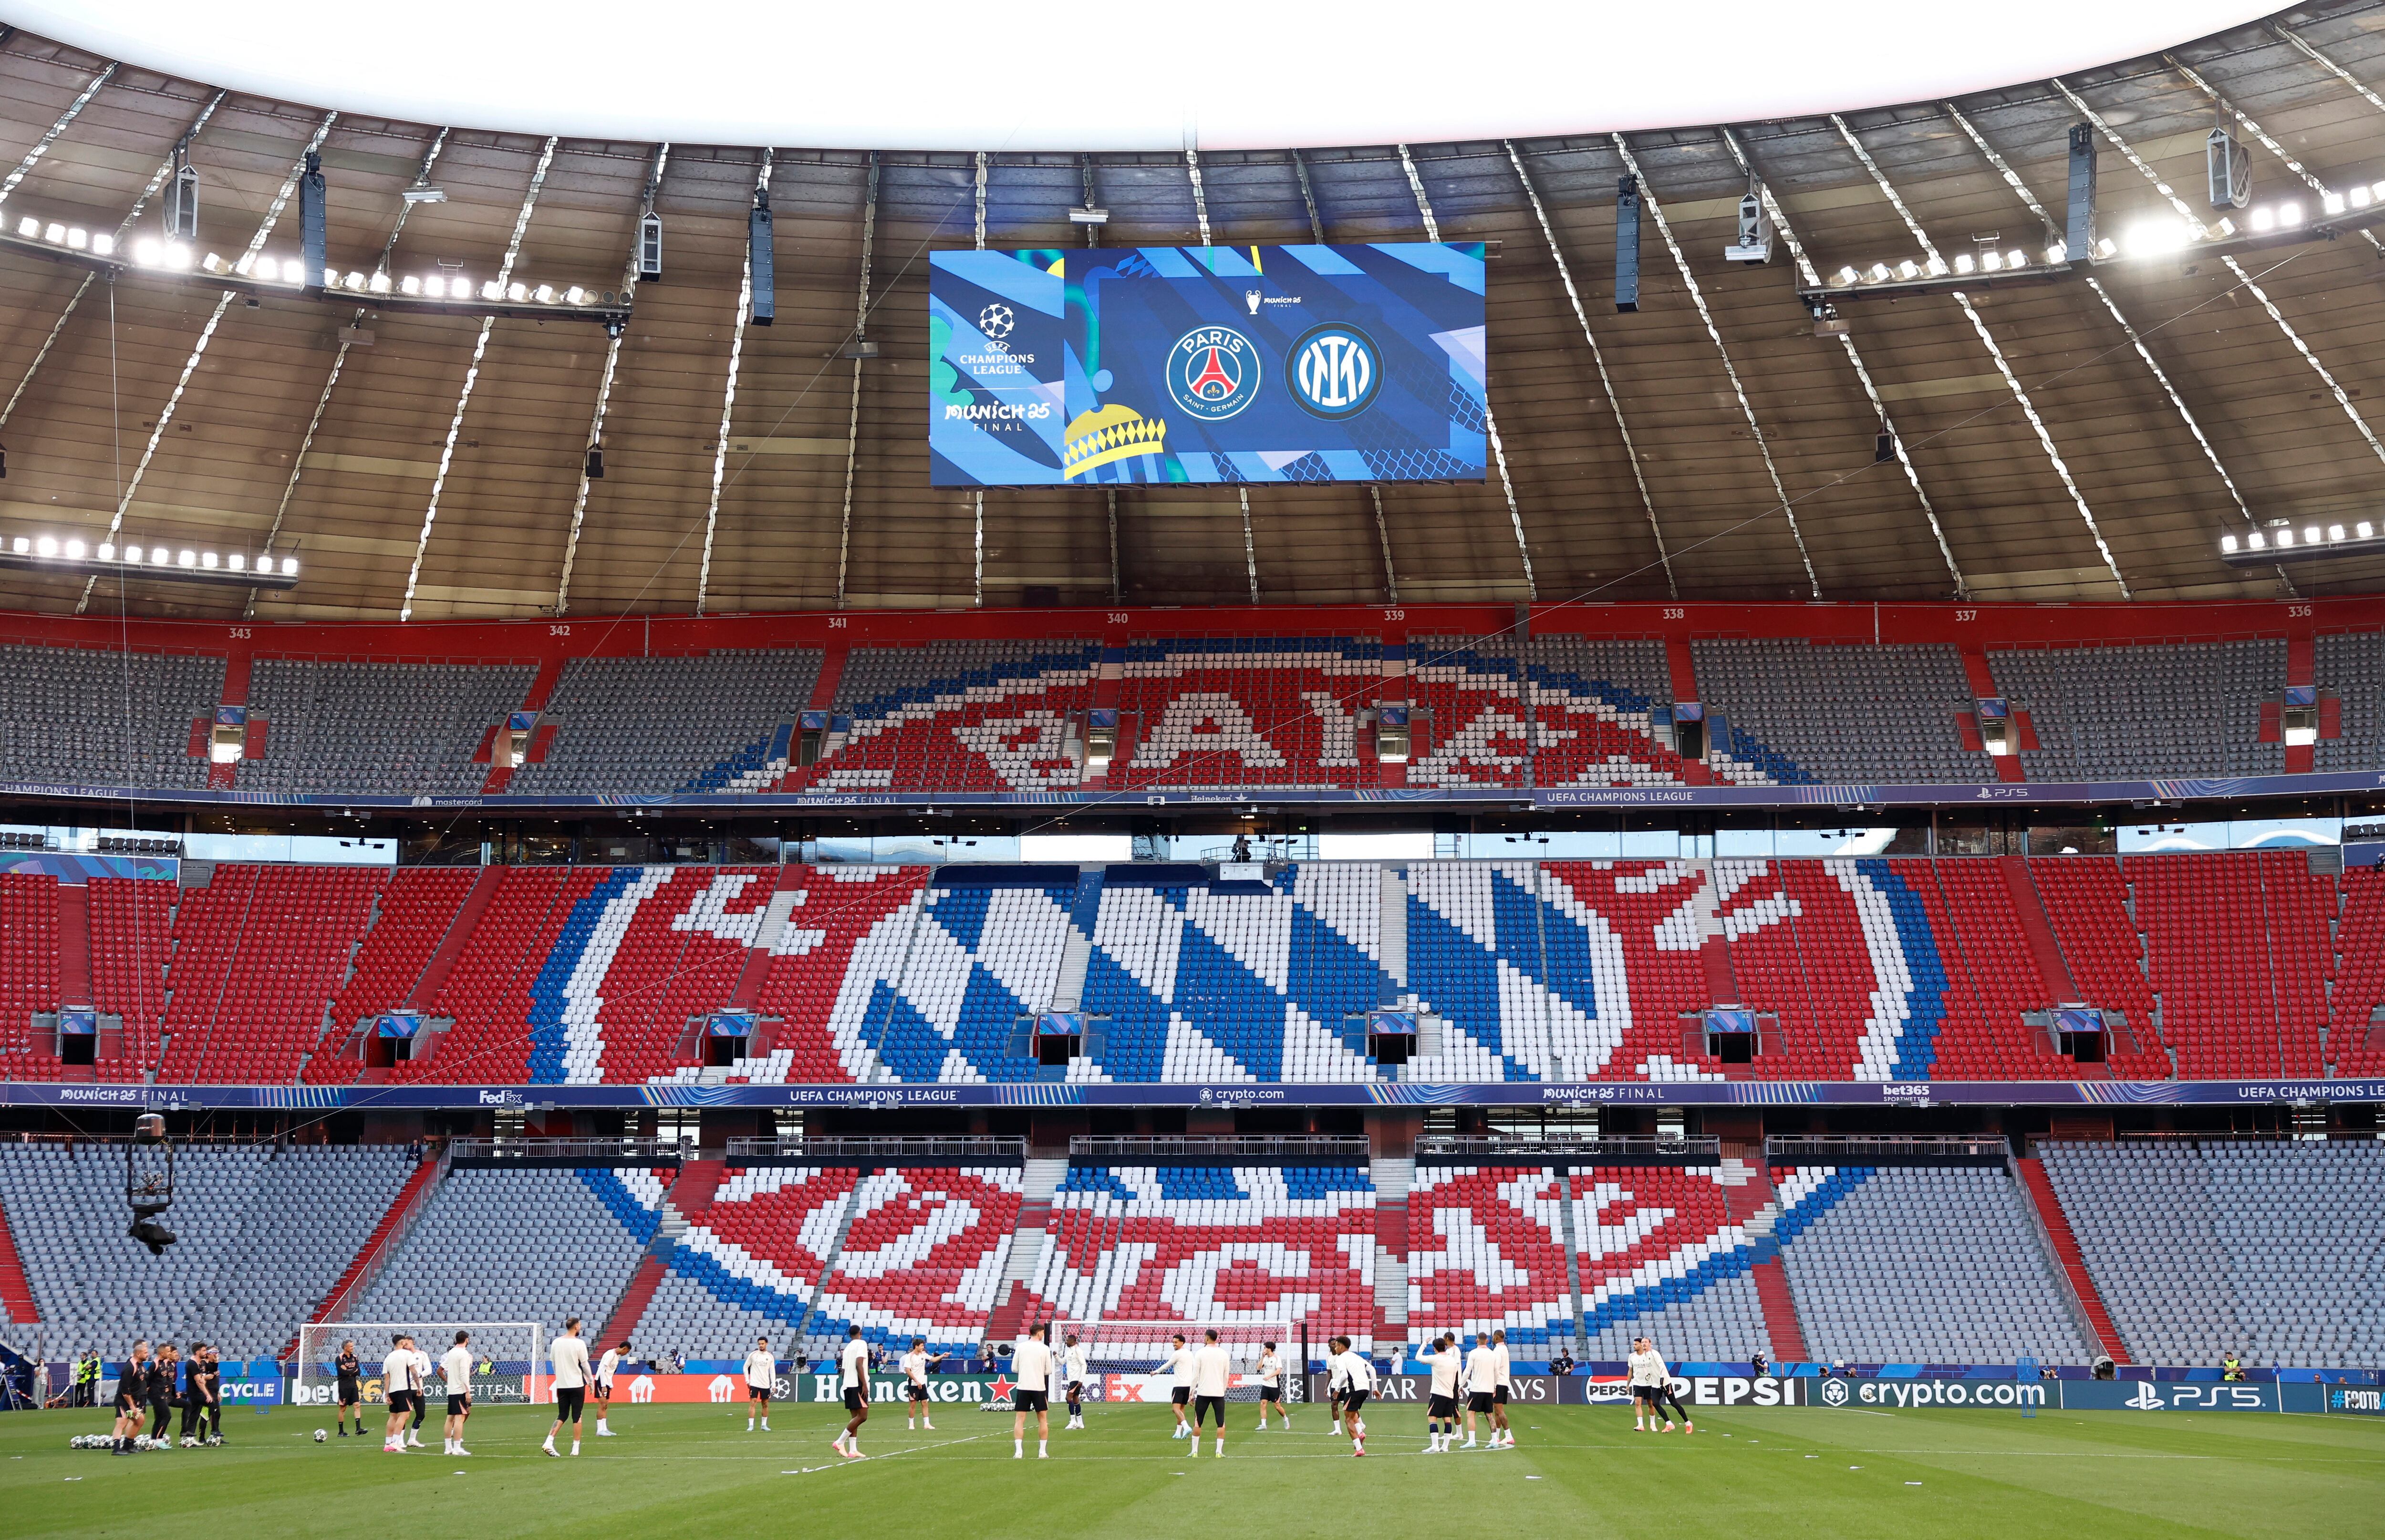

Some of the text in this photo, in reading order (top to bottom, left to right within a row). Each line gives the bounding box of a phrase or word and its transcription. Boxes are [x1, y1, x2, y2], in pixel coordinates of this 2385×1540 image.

[985, 343, 1008, 352] UEFA
[1182, 331, 1244, 353] PARIS
[960, 354, 1035, 364] CHAMPIONS
[973, 365, 1022, 374] LEAGUE
[1027, 403, 1050, 419] 25
[974, 423, 1022, 431] FINAL
[1384, 610, 1405, 620] 339
[1663, 609, 1684, 619] 338
[1956, 610, 1977, 621] 337
[2289, 605, 2312, 617] 336
[829, 618, 847, 628] 341
[1108, 613, 1128, 623] 340
[229, 628, 251, 639] 343
[550, 625, 570, 636] 342
[1547, 792, 1693, 802] UEFA CHAMPIONS LEAGUE
[1994, 788, 2028, 796] PS5
[120, 1089, 137, 1100] 25
[141, 1091, 188, 1101] FINAL
[790, 1090, 957, 1101] UEFA CHAMPIONS LEAGUE
[1216, 1089, 1284, 1100] crypto.com
[1599, 1087, 1614, 1099] 25
[1619, 1088, 1664, 1098] FINAL
[1883, 1085, 1929, 1095] bet365
[2239, 1087, 2276, 1097] UEFA
[2280, 1085, 2364, 1097] CHAMPIONS
[479, 1090, 523, 1104] FedEx
[219, 1383, 274, 1397] CYCLE
[1589, 1385, 1632, 1395] PEPSI
[1666, 1377, 1795, 1406] PEPSI
[1860, 1379, 2045, 1407] crypto.com
[2173, 1386, 2261, 1407] PS5
